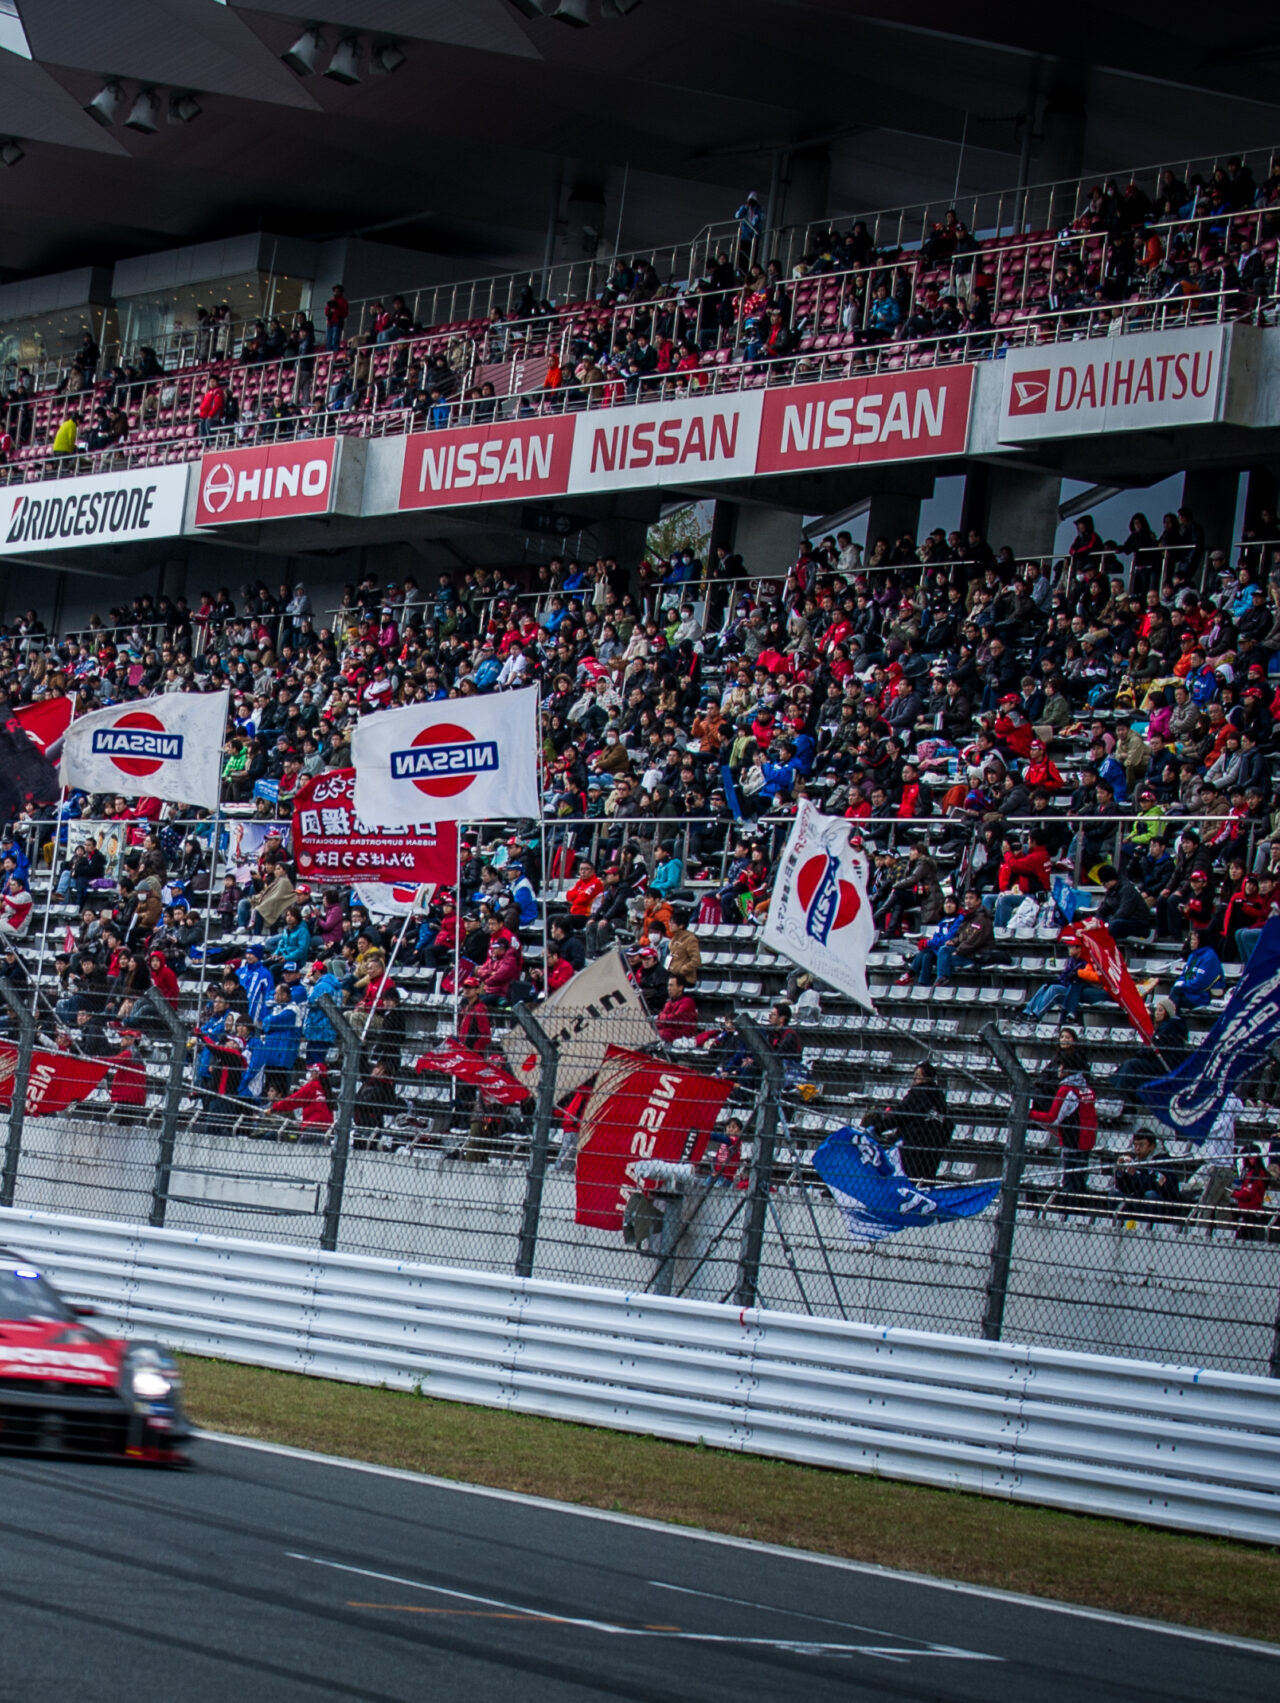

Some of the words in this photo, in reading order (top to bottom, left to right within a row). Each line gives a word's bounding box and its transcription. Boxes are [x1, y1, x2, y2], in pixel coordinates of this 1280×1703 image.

[1054, 348, 1214, 413] DAIHATSU
[590, 411, 740, 474] NISSAN
[780, 386, 947, 454] NISSAN
[236, 457, 328, 503] HINO
[419, 432, 554, 493] NISSAN
[6, 485, 158, 544] BRIDGESTONE
